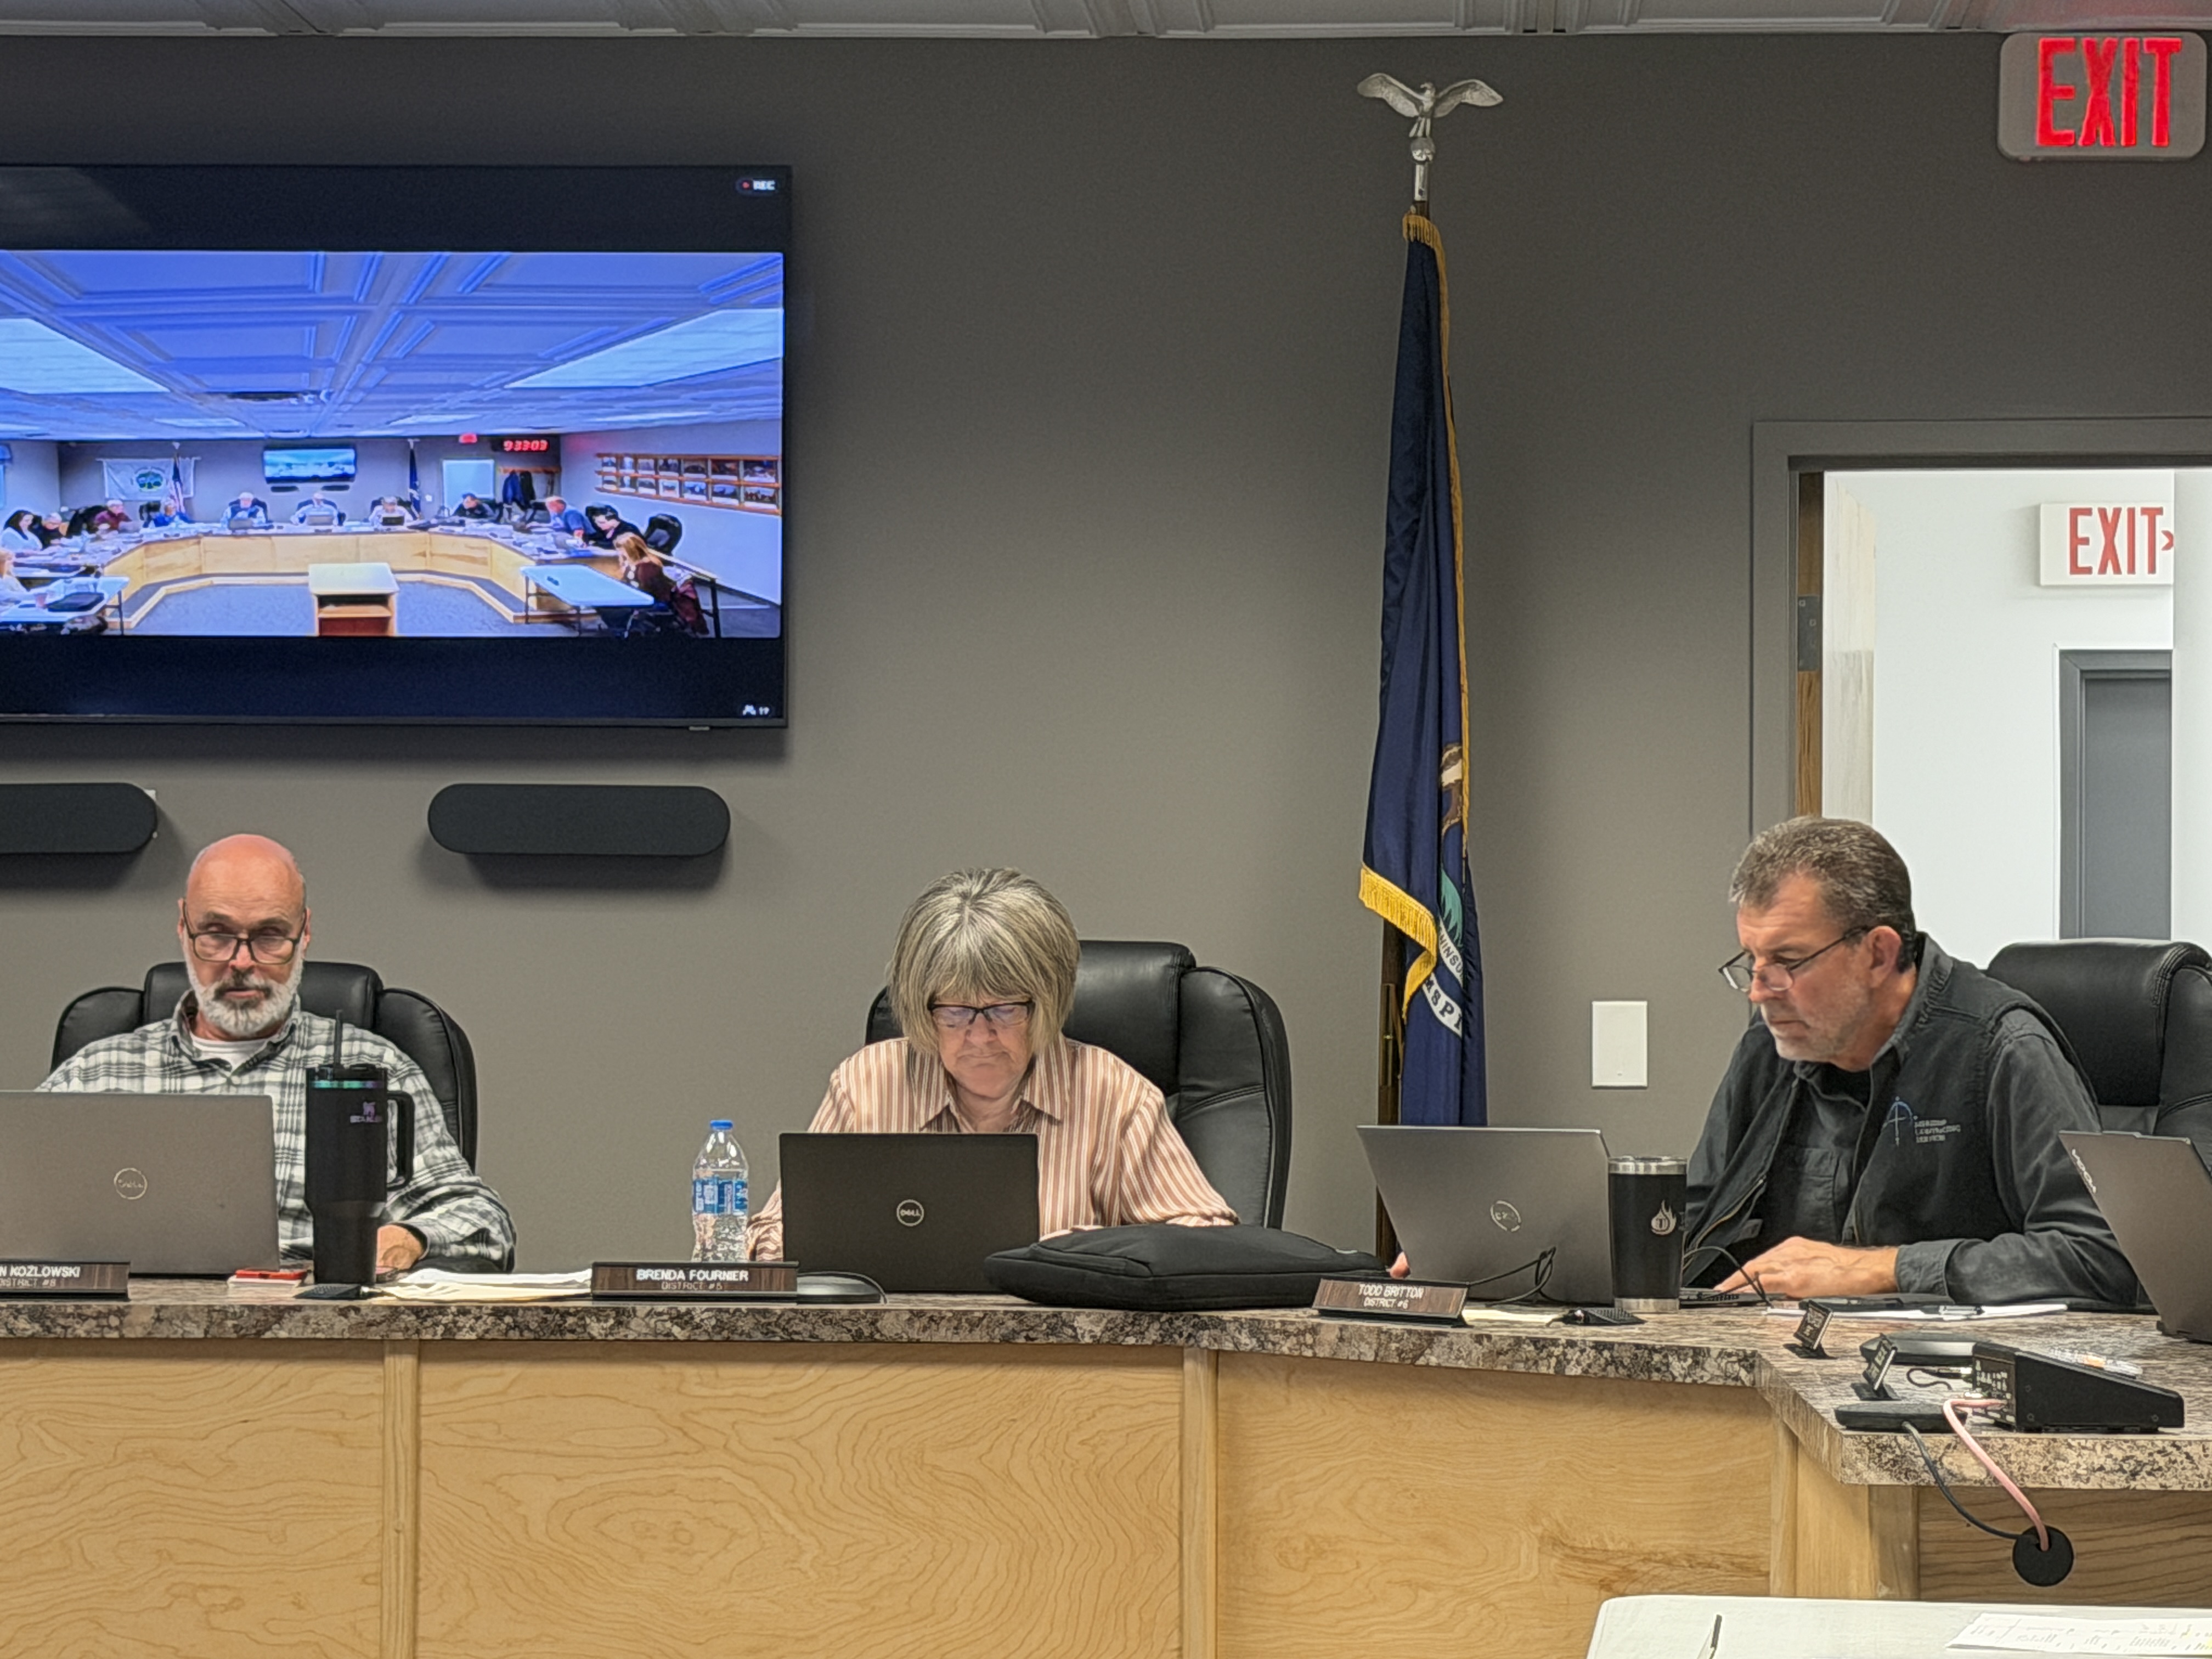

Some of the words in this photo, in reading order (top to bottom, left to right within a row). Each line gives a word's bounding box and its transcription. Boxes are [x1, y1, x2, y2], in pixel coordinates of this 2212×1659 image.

[2036, 37, 2182, 148] EXIT
[2069, 506, 2164, 575] EXIT
[10, 1265, 81, 1278] KOZLOWSKI
[636, 1268, 686, 1281] BRENDA
[689, 1269, 749, 1282] FOURNIER
[661, 1281, 704, 1290] DISTRICT
[1358, 1283, 1383, 1296] TODD
[1383, 1285, 1424, 1299] BRITTON
[1363, 1296, 1397, 1308] DISTRICT
